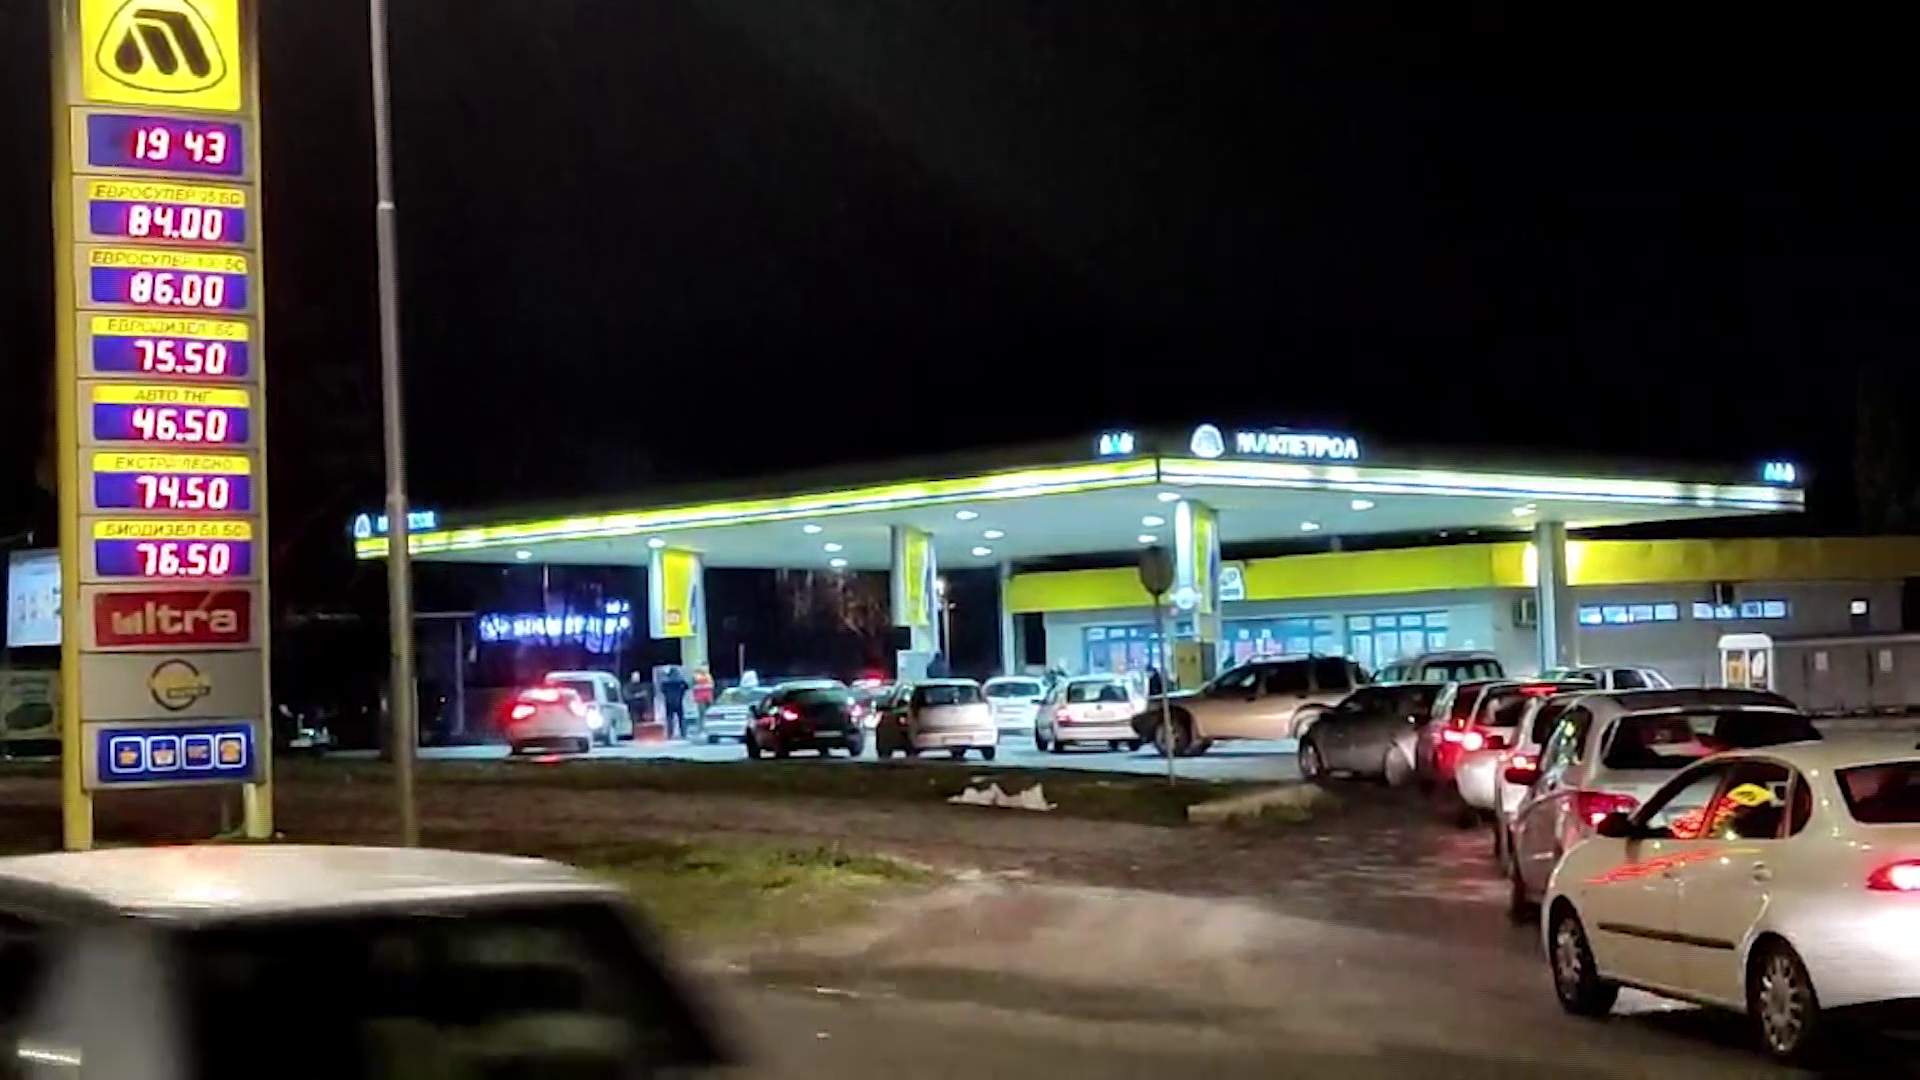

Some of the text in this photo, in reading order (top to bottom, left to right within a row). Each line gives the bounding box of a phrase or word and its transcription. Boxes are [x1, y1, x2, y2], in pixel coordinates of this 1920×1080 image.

[135, 127, 227, 165] 19 43
[128, 204, 224, 240] 84.00
[130, 271, 225, 308] 86.00
[134, 339, 227, 375] 75.50
[134, 389, 213, 403] АВТО ТНГ
[132, 407, 228, 443] 46.50
[135, 475, 229, 510] 74.50
[104, 523, 196, 537] БИОДИЗЕЛ
[135, 542, 230, 576] 76.50
[111, 600, 239, 636] ultra
